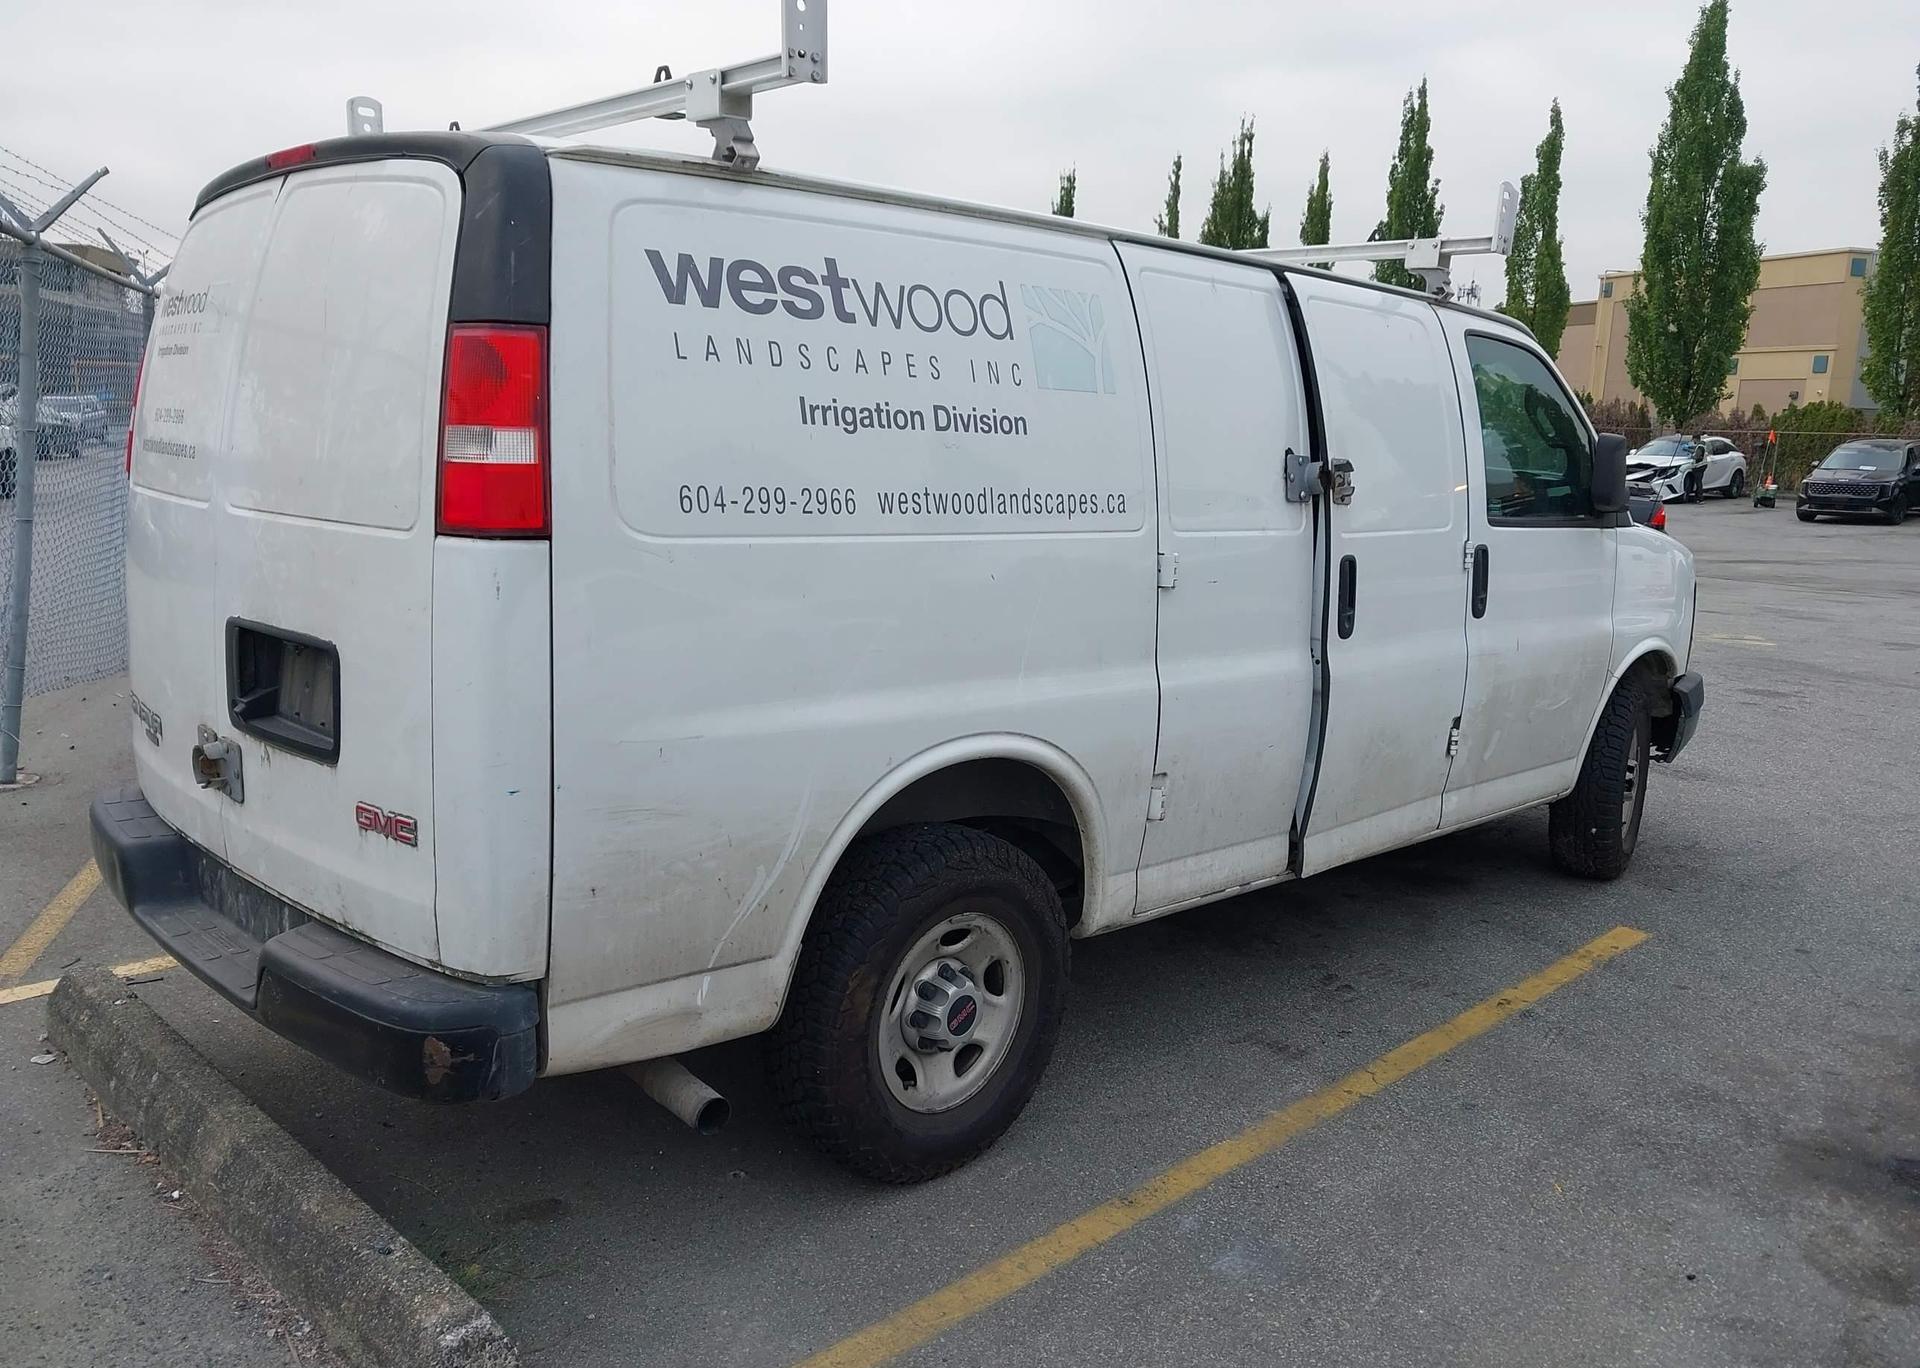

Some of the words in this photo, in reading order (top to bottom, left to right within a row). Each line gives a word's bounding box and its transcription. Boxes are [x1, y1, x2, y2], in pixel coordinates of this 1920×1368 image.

[644, 248, 1015, 341] westwood
[673, 331, 941, 381] LANDSCAPES
[970, 359, 1022, 387] INC
[799, 396, 925, 435] Irrigation
[933, 404, 1028, 436] Division
[679, 484, 857, 516] 604-299-2966
[877, 486, 1127, 521] westwoodlandscapes.ca
[355, 800, 418, 847] GMC
